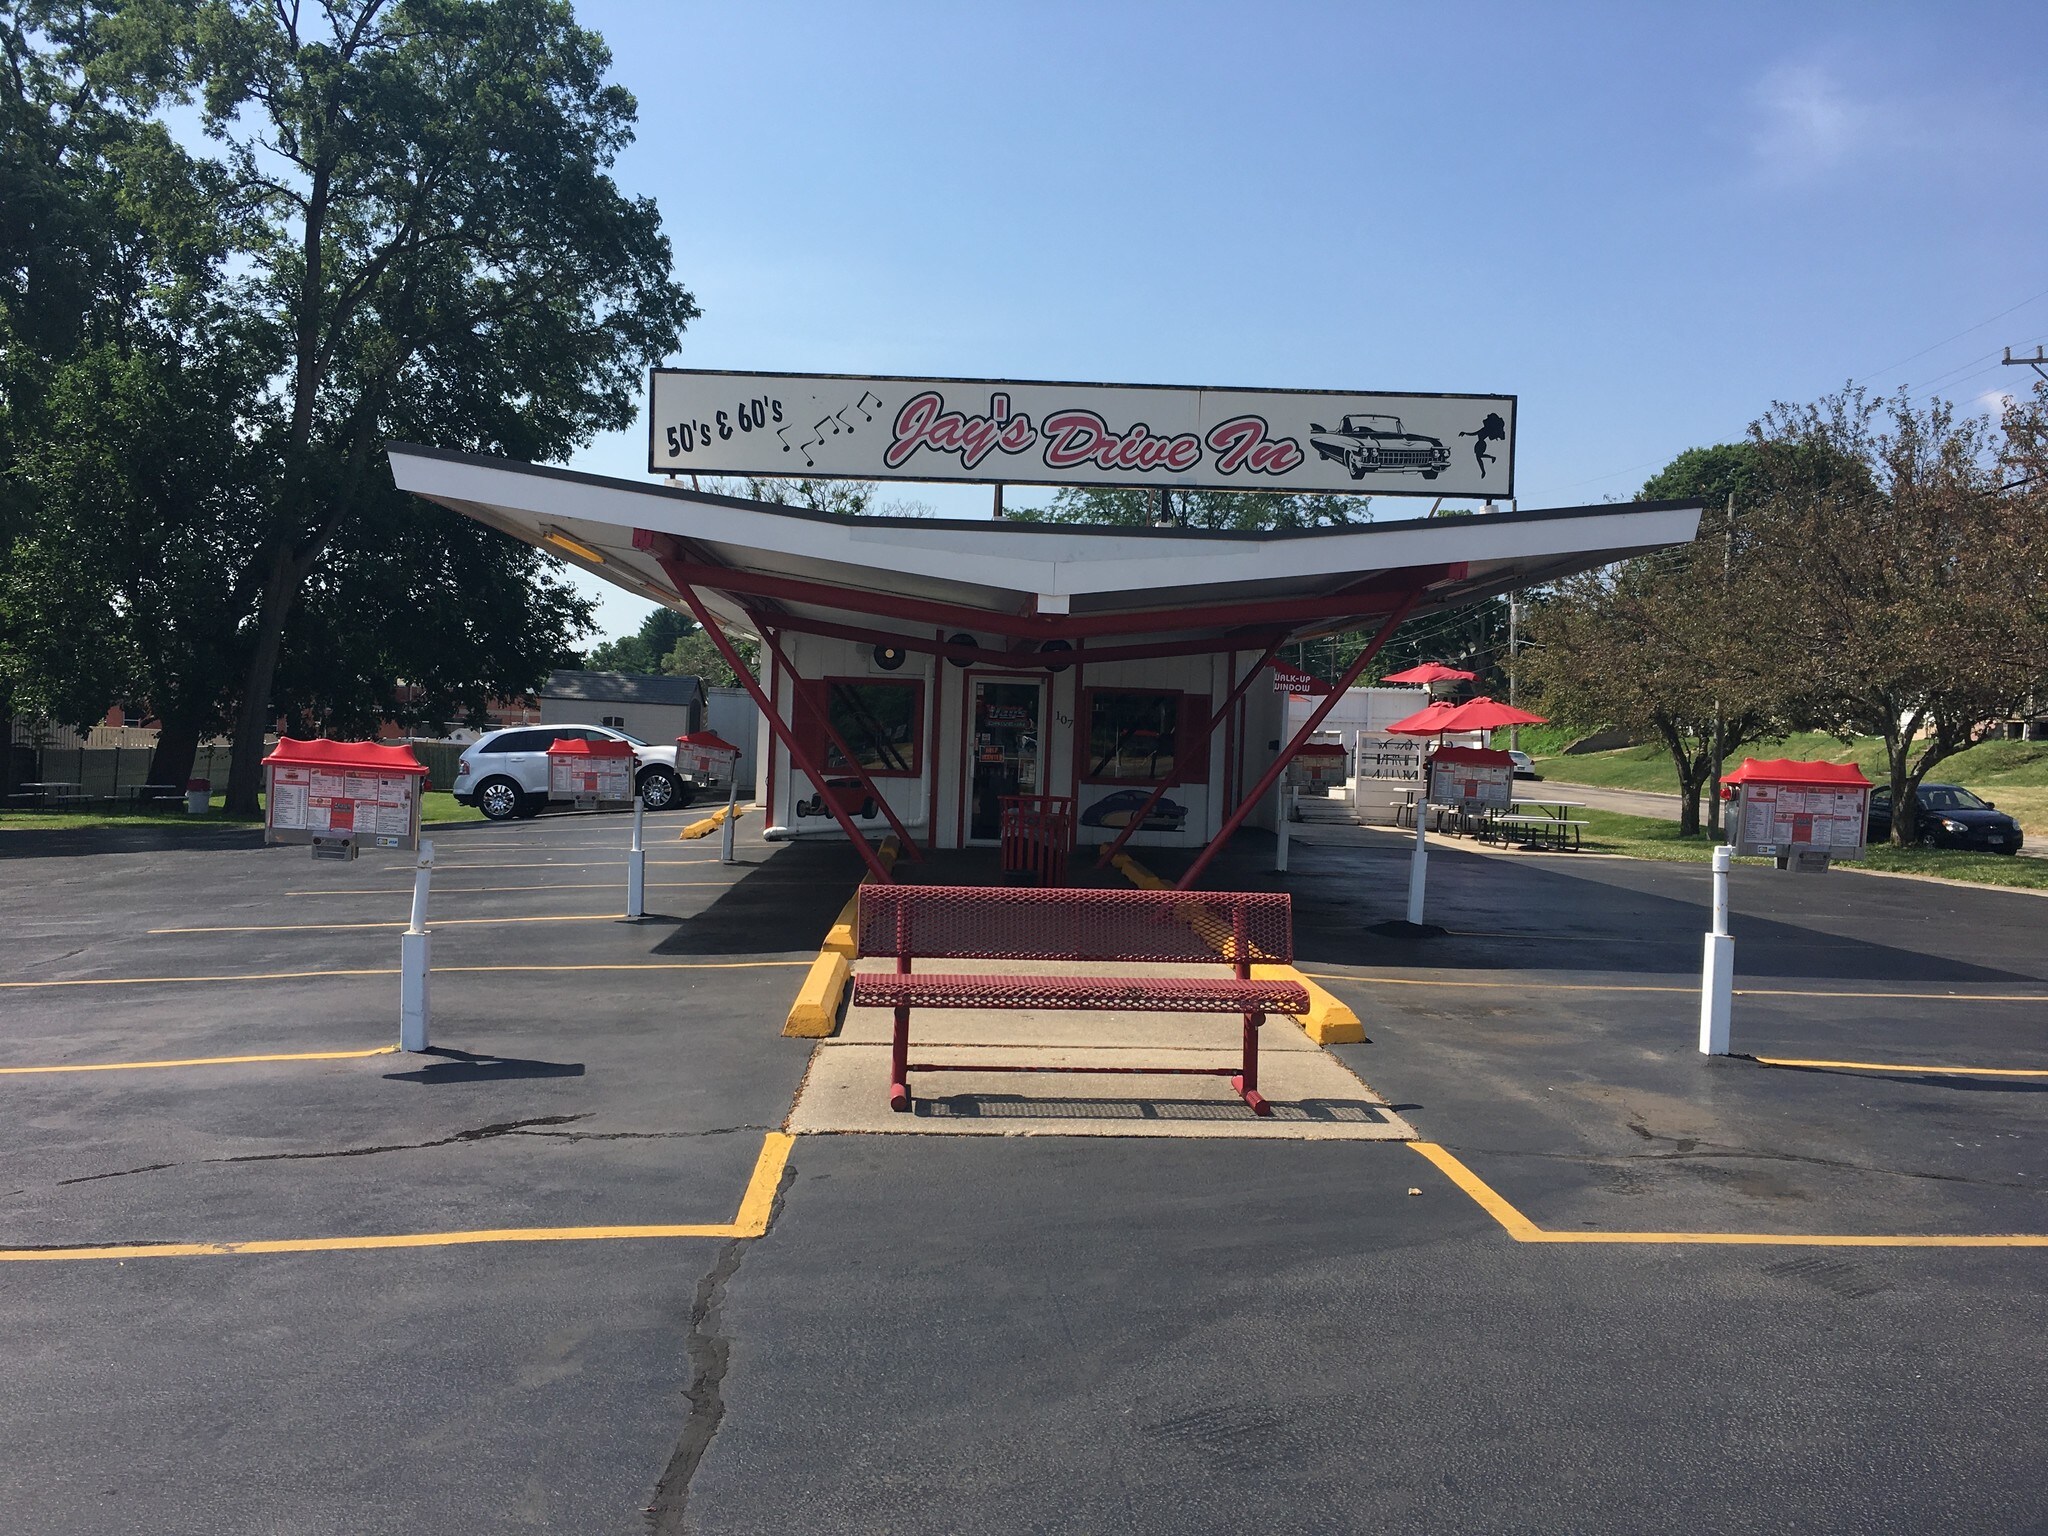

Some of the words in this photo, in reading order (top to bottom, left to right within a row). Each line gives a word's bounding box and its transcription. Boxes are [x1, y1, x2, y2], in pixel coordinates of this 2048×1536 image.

[667, 419, 711, 457] 50's
[738, 395, 783, 432] 60's
[883, 391, 1037, 470] Jay's
[1040, 408, 1202, 473] Drive
[1205, 414, 1304, 476] In
[1055, 711, 1074, 729] 107
